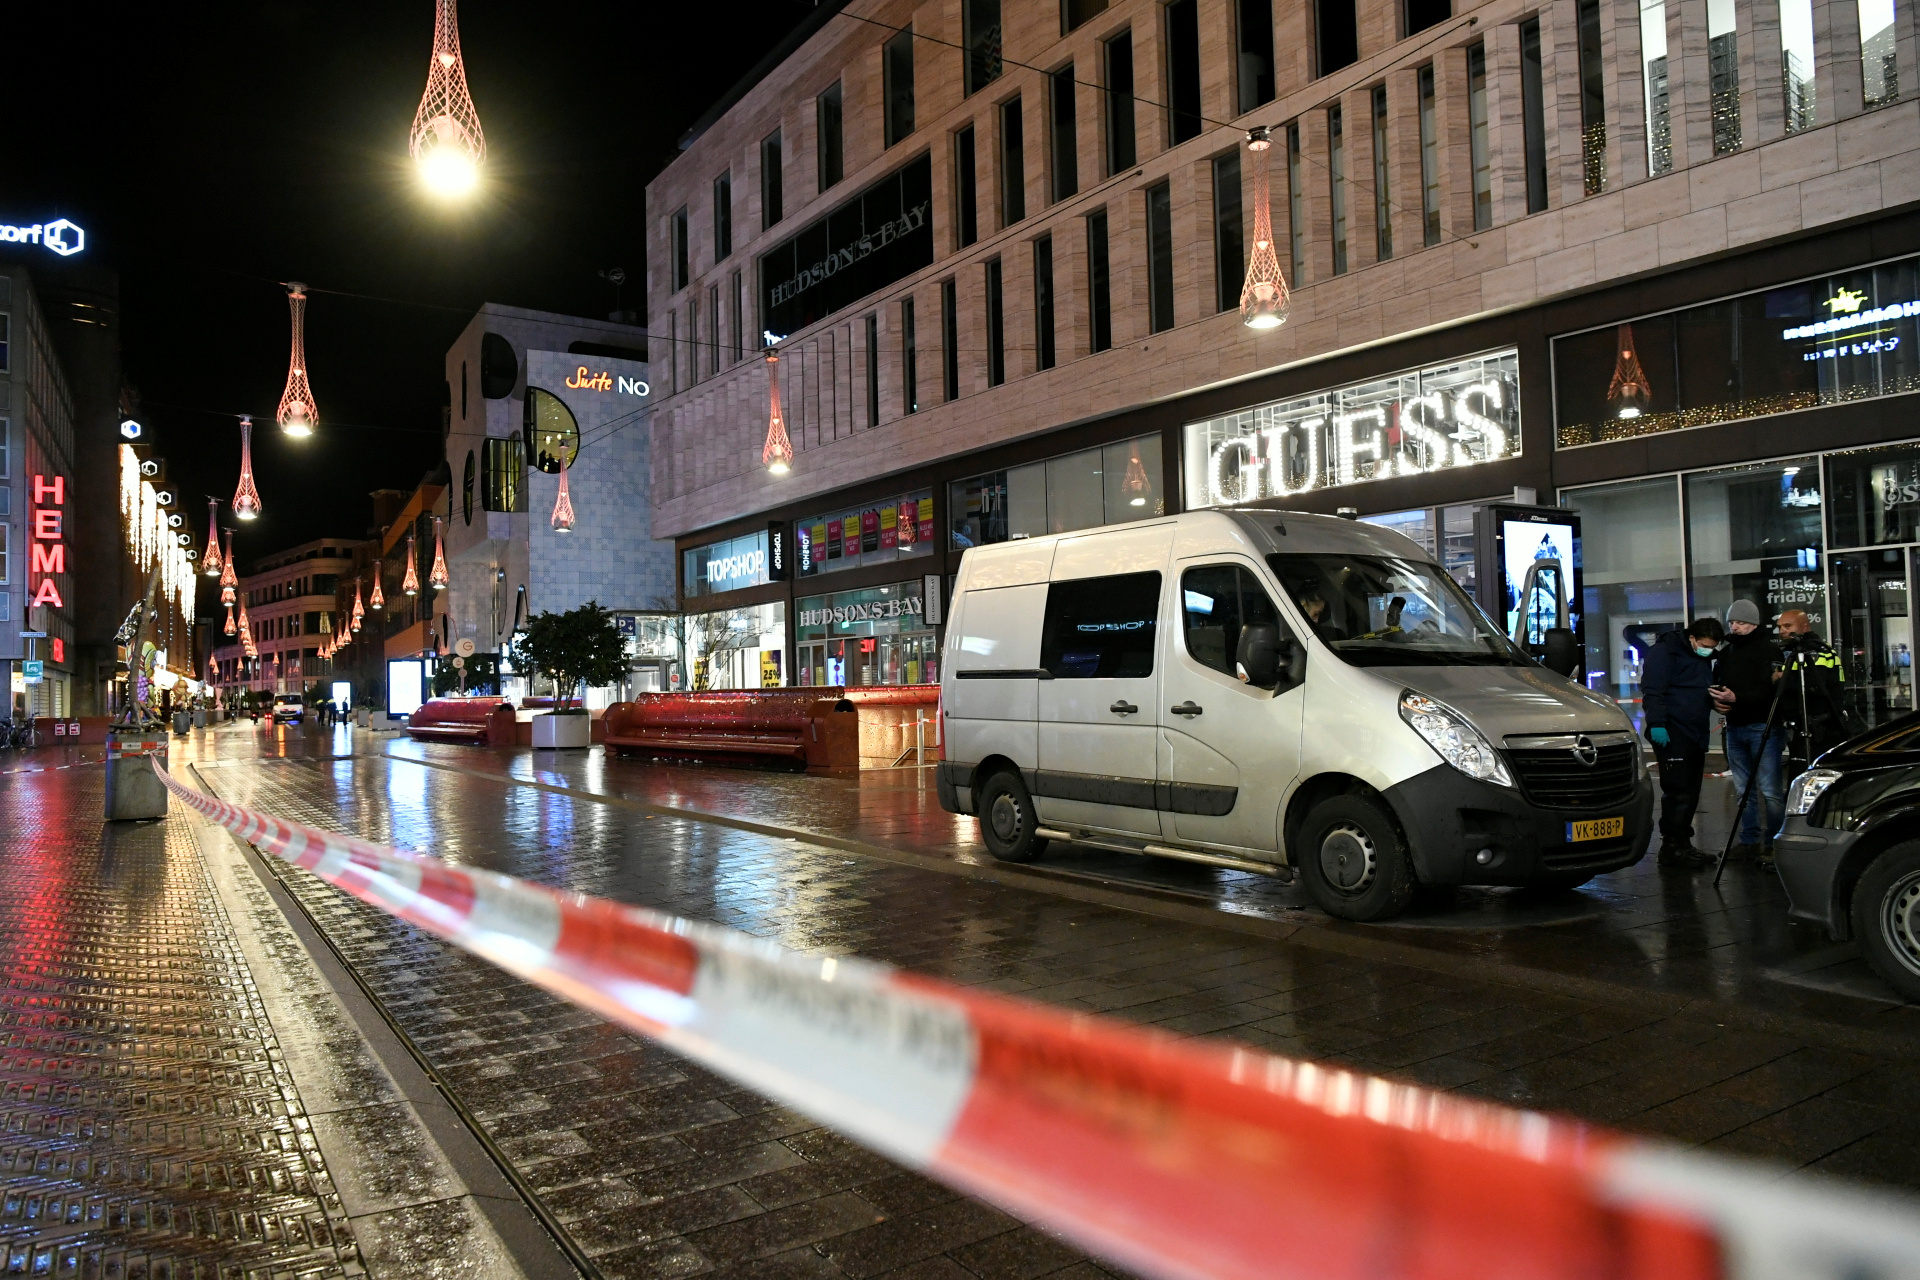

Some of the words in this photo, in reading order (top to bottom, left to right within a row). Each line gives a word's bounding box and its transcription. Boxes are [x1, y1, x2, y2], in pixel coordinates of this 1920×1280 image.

[770, 234, 873, 309] HUDSON'S
[880, 199, 929, 247] BAY
[565, 366, 613, 393] Suite
[618, 376, 650, 397] No
[1208, 378, 1506, 505] GUESS
[32, 475, 65, 608] HEMA
[774, 532, 782, 570] TOPSHOP
[707, 550, 765, 582] TOPSHOP
[1766, 591, 1817, 605] friday
[1768, 576, 1813, 591] Black
[799, 601, 884, 627] HUDSON'S
[887, 596, 923, 618] BAY
[463, 641, 473, 651] G
[763, 669, 781, 681] 25%
[1575, 819, 1621, 839] VK-888-P
